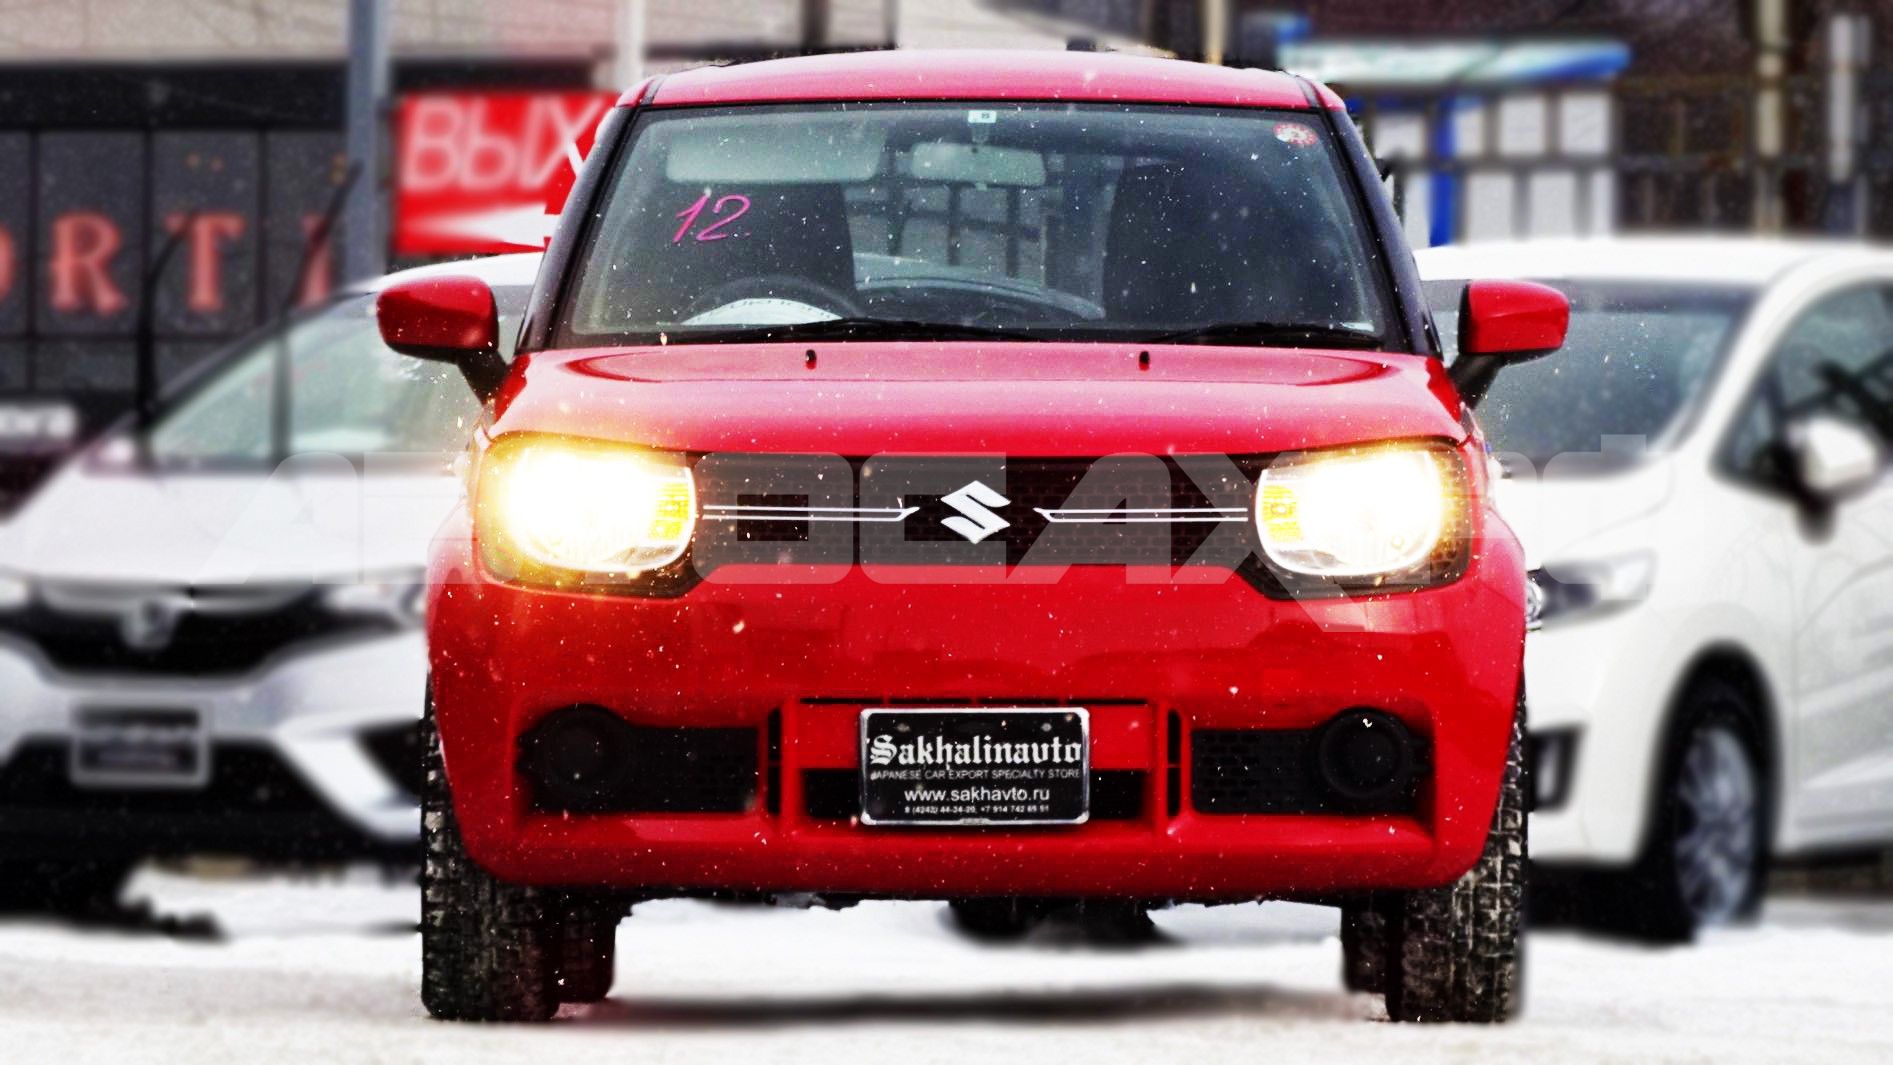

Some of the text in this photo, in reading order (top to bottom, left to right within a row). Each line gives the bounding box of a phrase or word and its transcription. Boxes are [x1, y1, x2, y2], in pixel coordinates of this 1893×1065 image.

[672, 190, 750, 244] 12
[870, 734, 1082, 771] Sakhalinavto
[925, 769, 946, 779] CAR
[949, 769, 990, 779] EXPORT
[992, 769, 1045, 779] SPECIALTY
[1048, 768, 1080, 779] STORE
[904, 786, 1050, 801] www.sakhavto.ru
